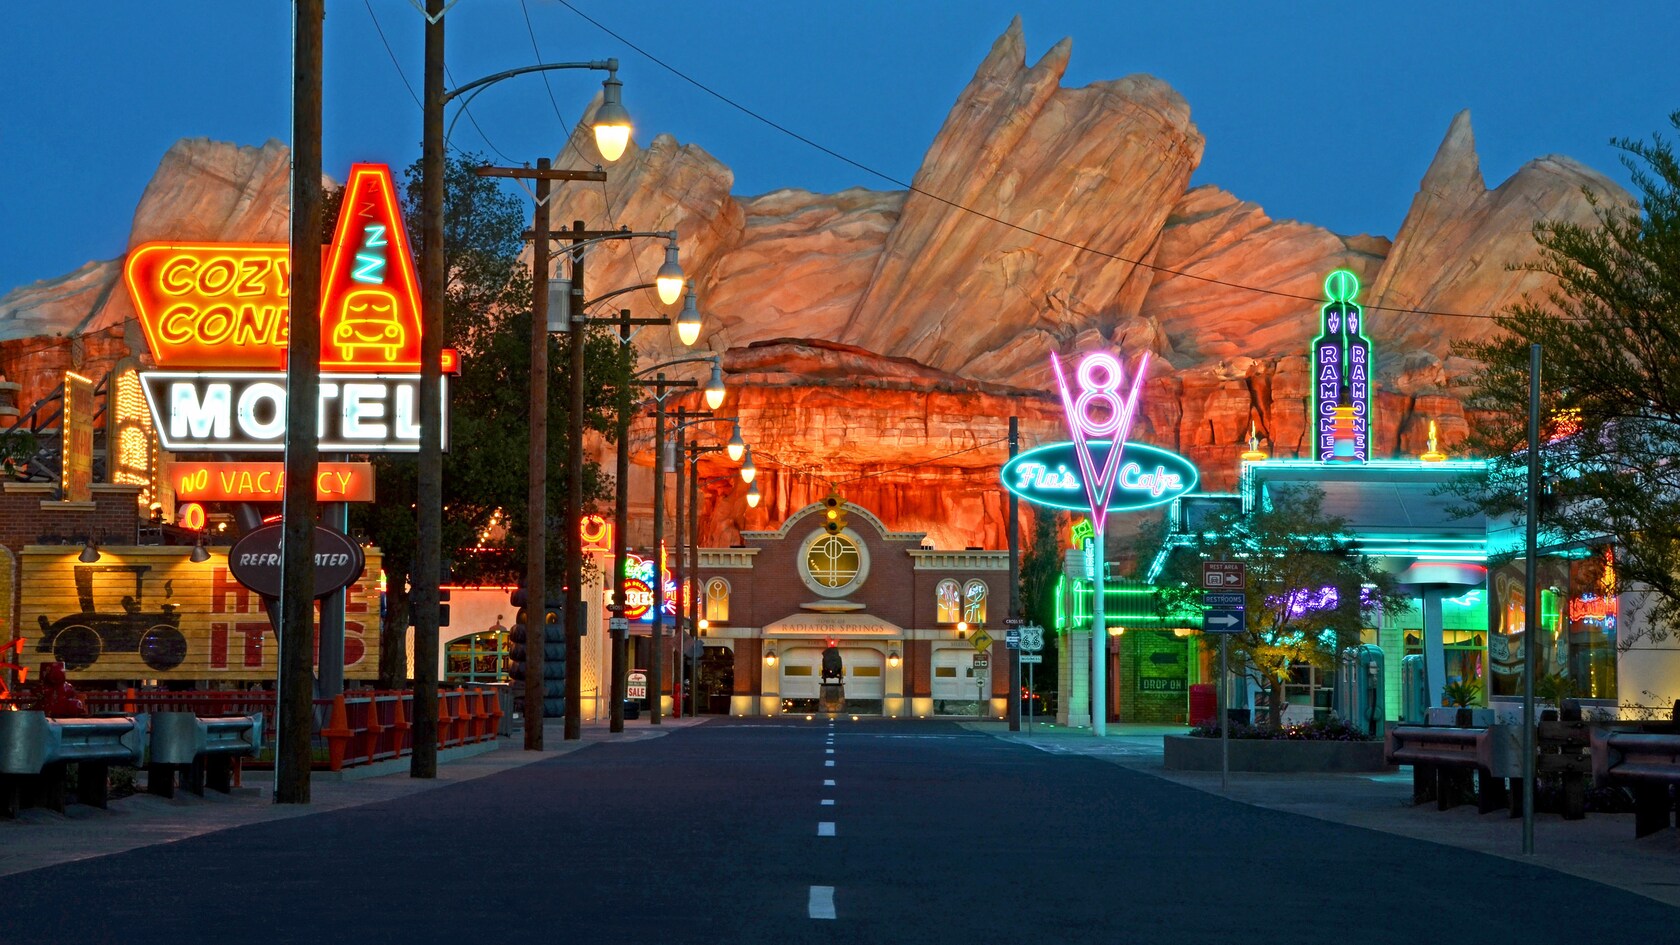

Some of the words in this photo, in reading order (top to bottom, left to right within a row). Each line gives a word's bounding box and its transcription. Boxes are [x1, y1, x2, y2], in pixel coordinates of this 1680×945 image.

[160, 254, 289, 297] COZY
[159, 302, 289, 345] CONE
[181, 469, 208, 494] NO
[220, 471, 352, 495] VACACY
[1016, 463, 1081, 488] Flo's
[240, 553, 349, 567] REFRIATED
[211, 566, 369, 614] HE
[781, 623, 835, 632] RADIATOR
[840, 624, 884, 632] SPRINGS
[209, 622, 276, 669] IT
[1021, 634, 1042, 649] 66
[628, 687, 645, 697] SALE
[1143, 679, 1168, 690] DROP
